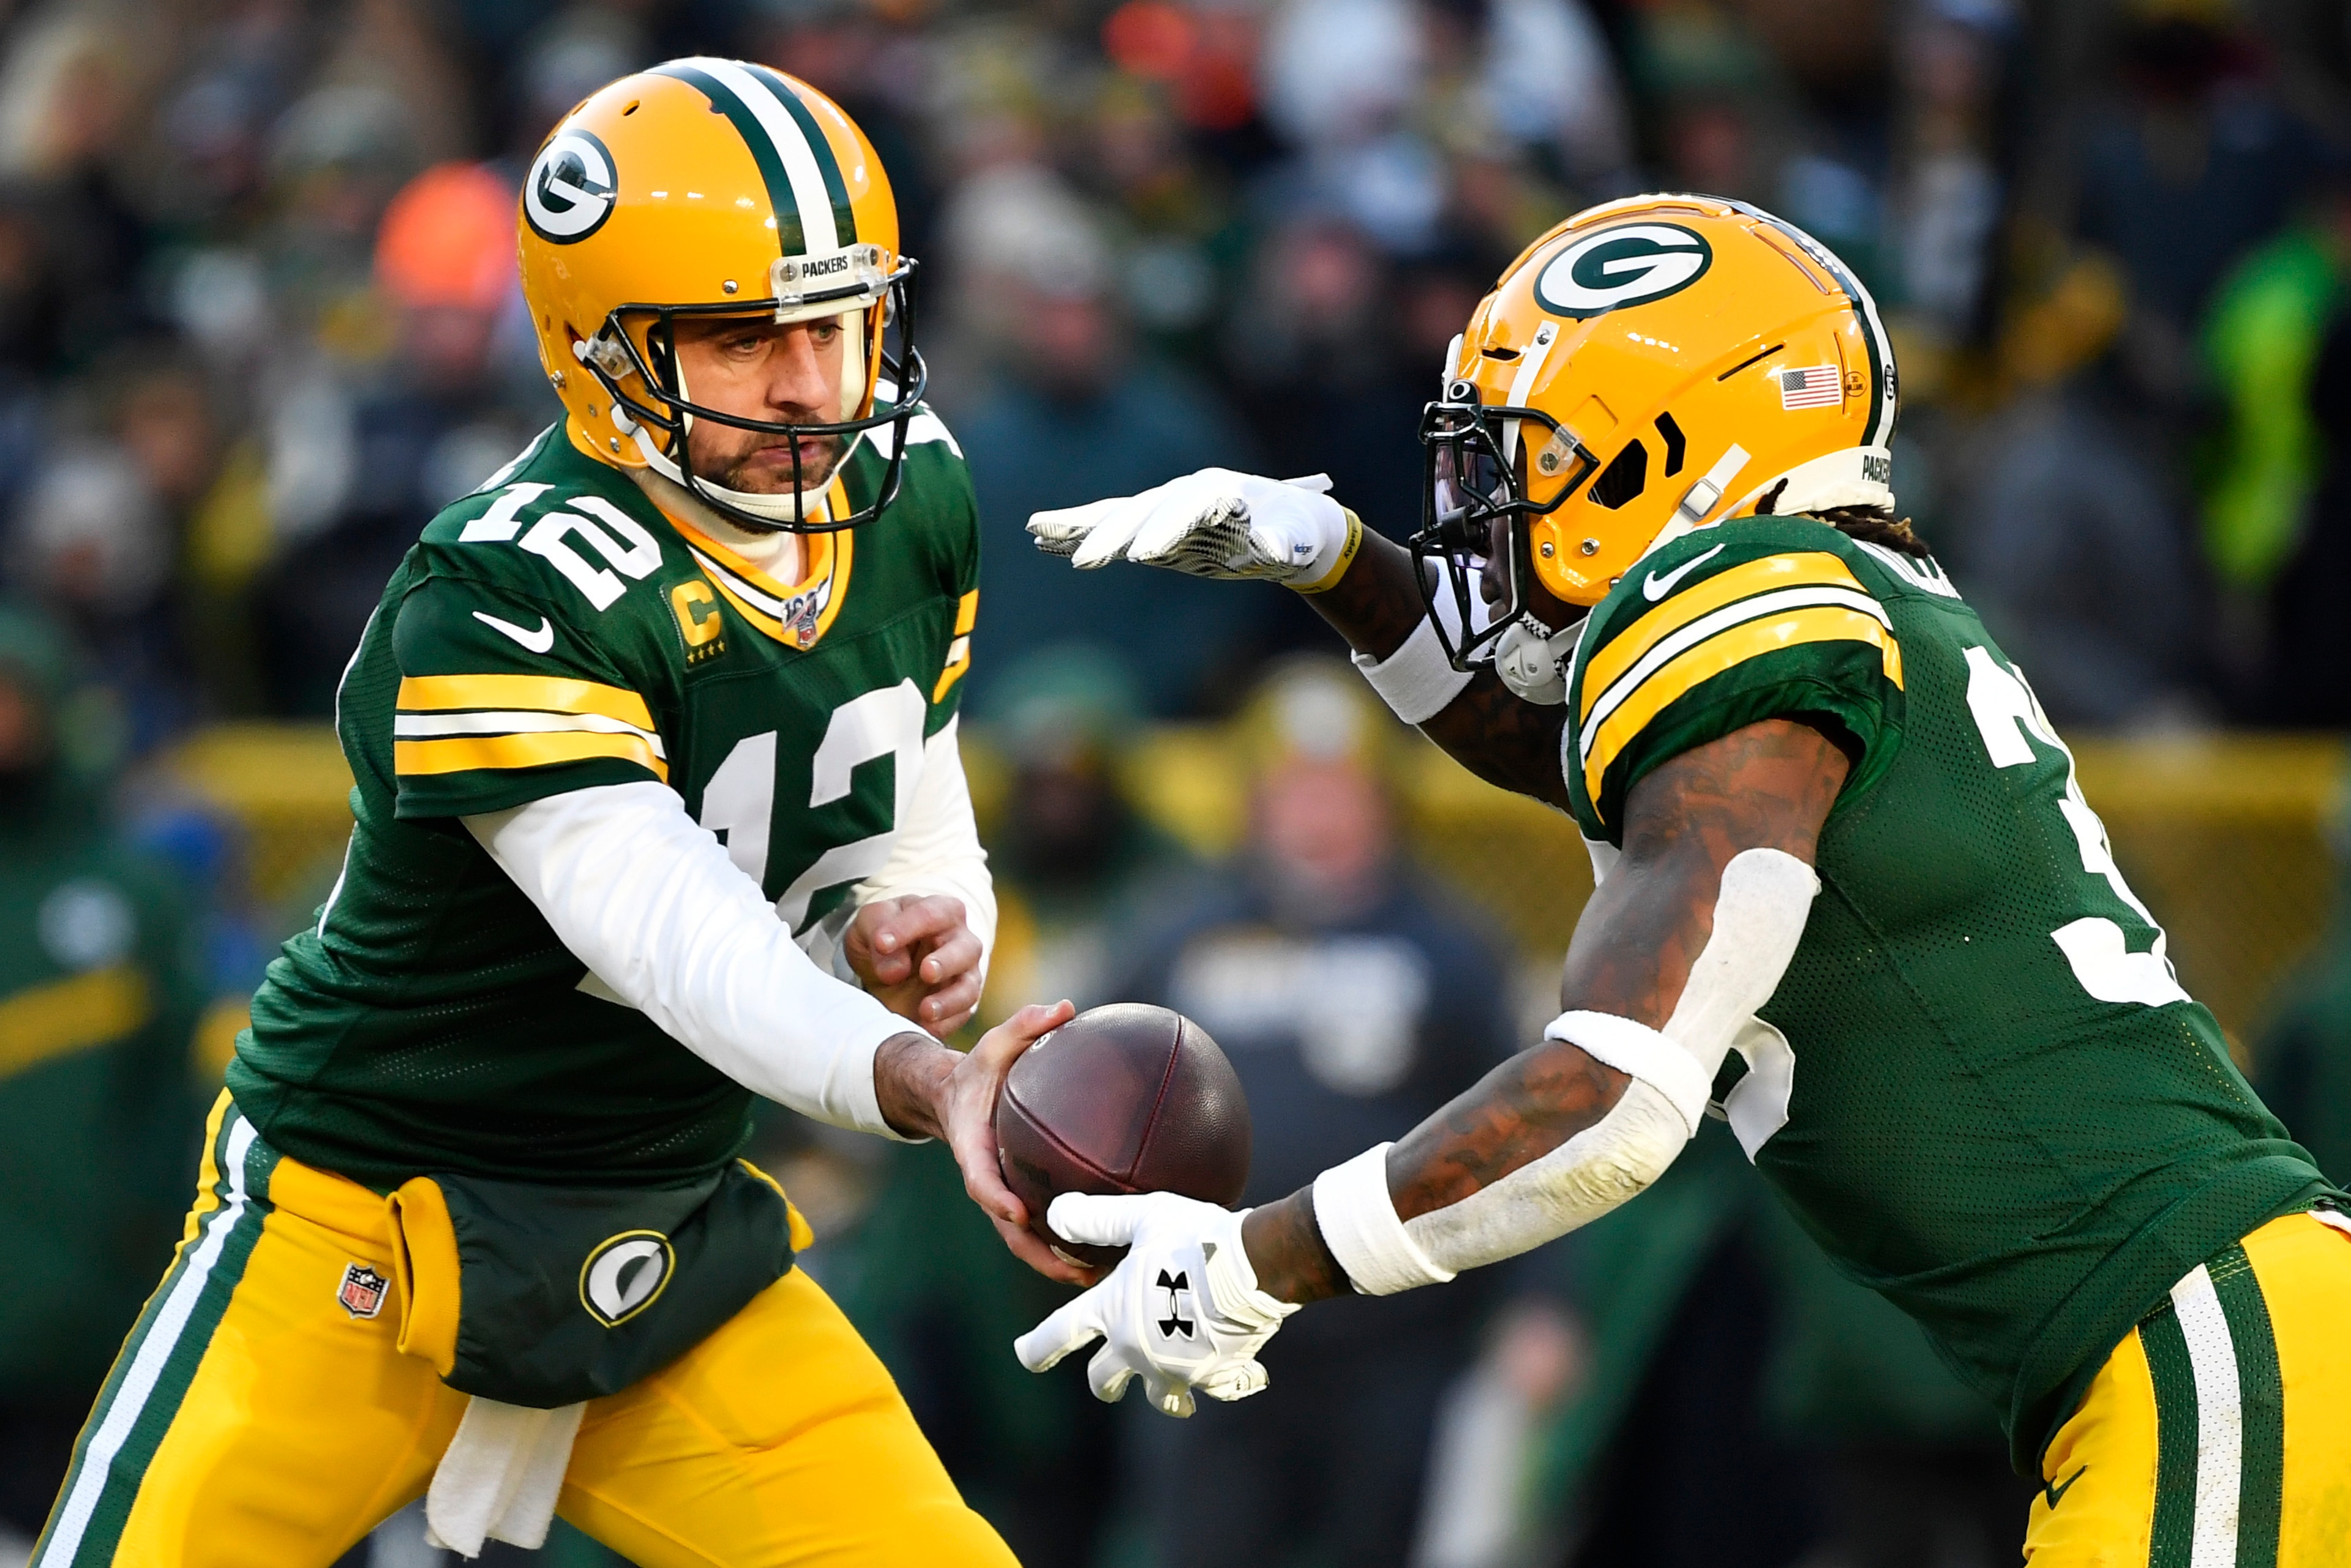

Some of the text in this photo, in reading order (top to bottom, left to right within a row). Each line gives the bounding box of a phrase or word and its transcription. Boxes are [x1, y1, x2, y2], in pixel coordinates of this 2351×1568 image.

[803, 255, 849, 278] PACKERS
[1540, 225, 1704, 309] G
[458, 482, 664, 612] 12
[671, 579, 722, 647] C
[699, 677, 926, 955] 12
